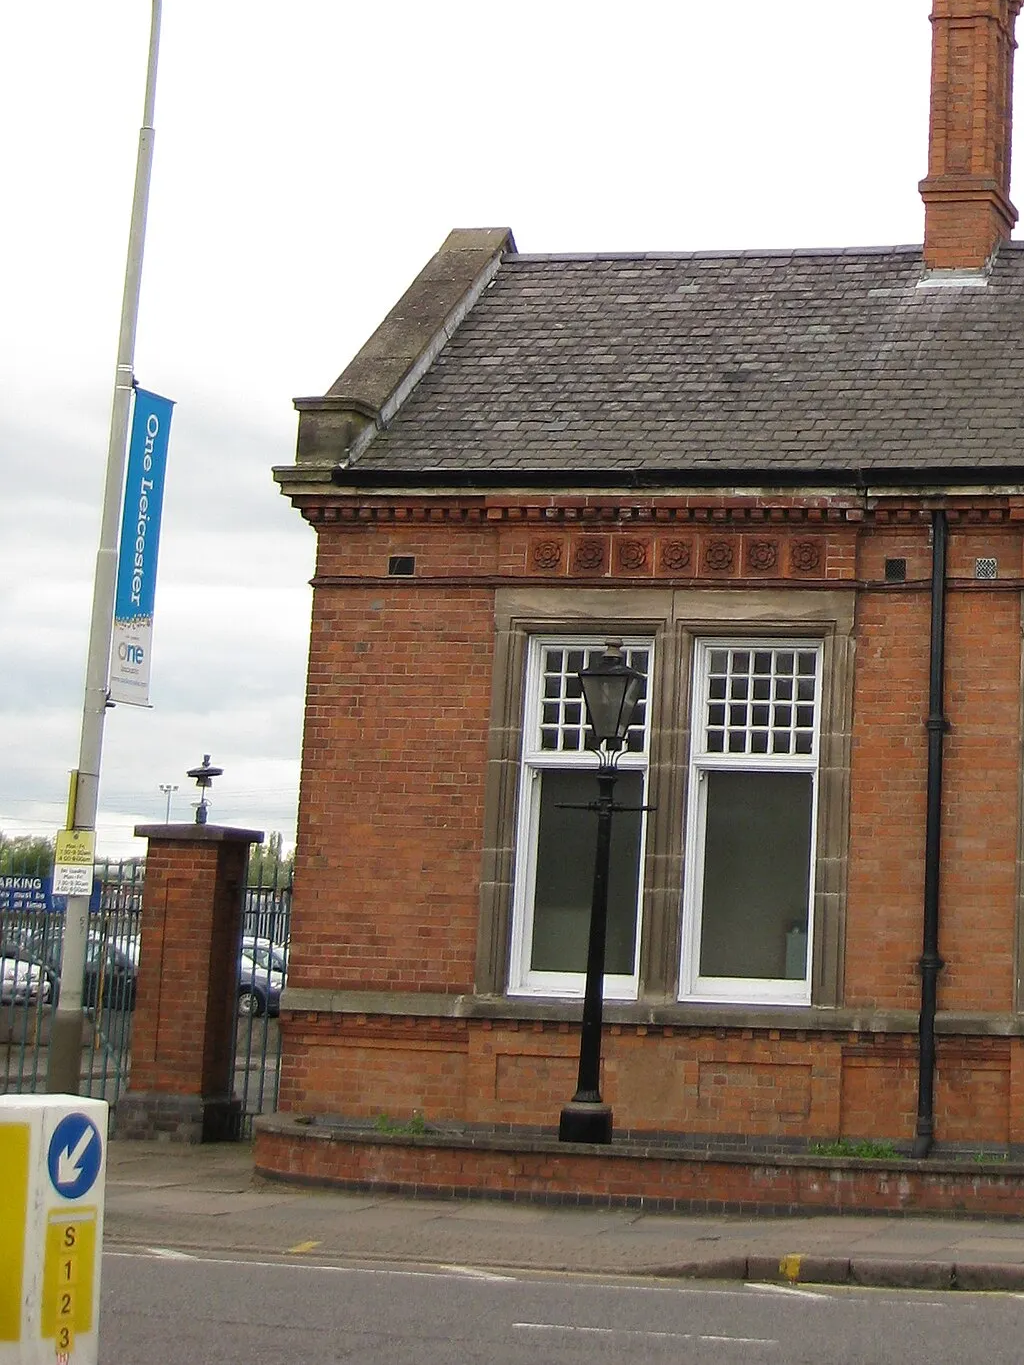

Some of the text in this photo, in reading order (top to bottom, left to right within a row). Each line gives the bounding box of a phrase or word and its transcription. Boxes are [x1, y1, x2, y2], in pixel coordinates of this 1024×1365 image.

[130, 413, 160, 606] One Leicester
[0, 877, 42, 889] ARKING
